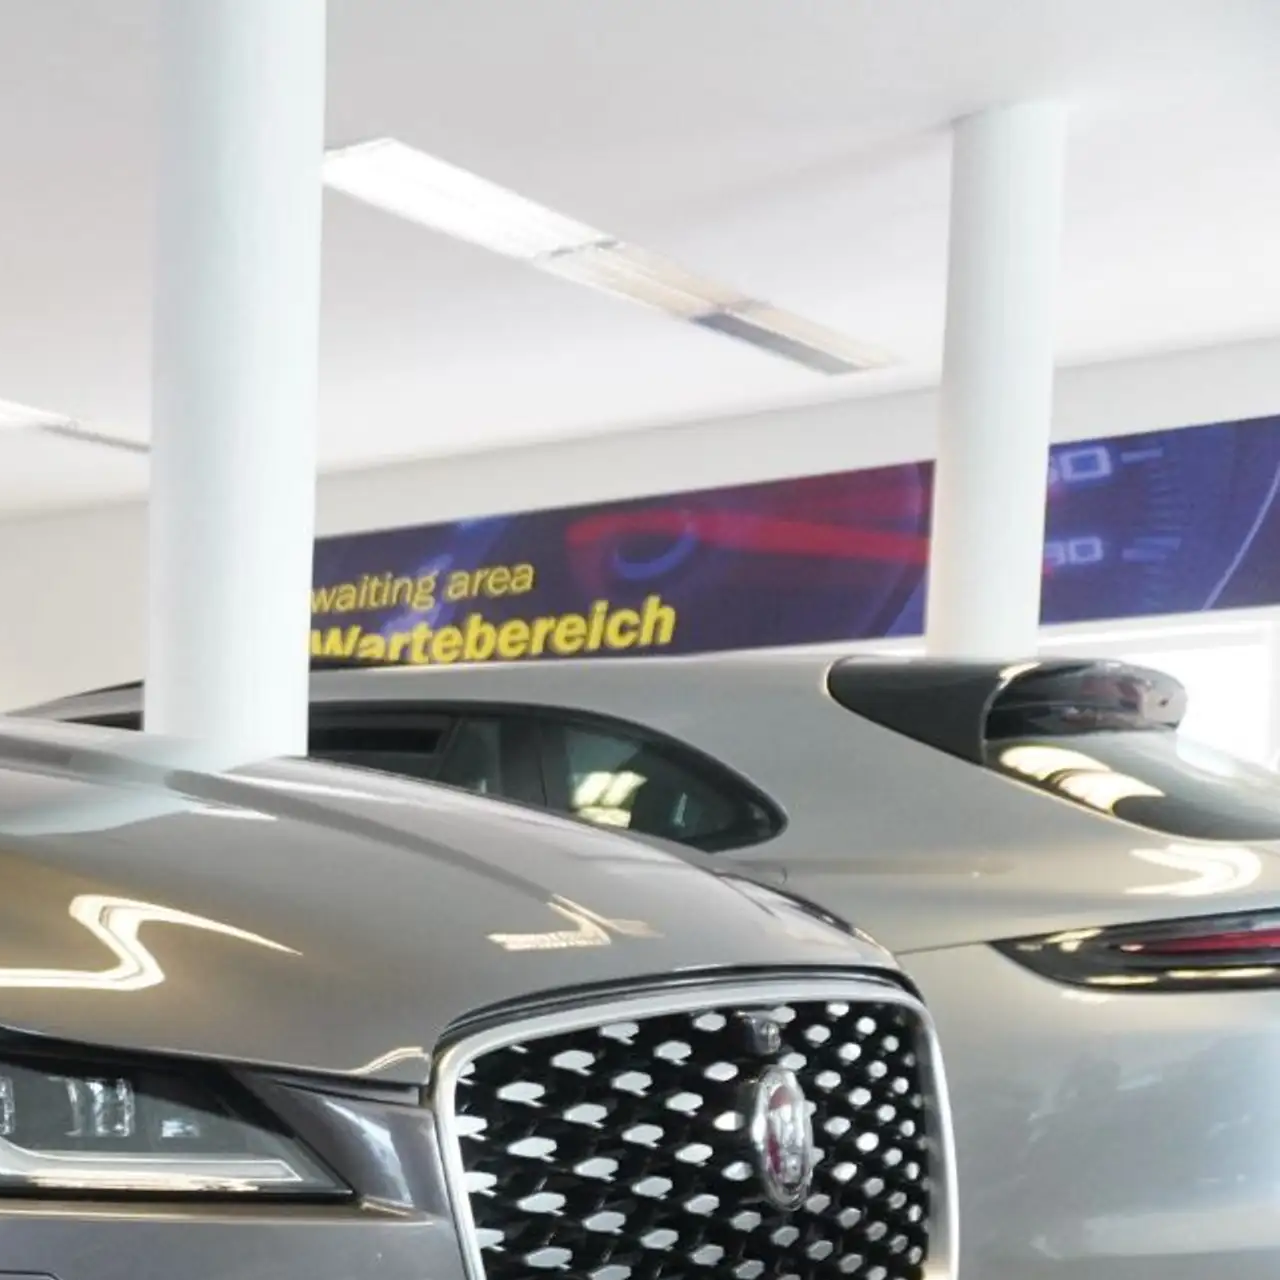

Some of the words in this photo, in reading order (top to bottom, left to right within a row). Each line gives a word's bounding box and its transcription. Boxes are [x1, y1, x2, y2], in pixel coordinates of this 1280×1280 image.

[310, 570, 438, 611] waiting
[447, 563, 534, 599] area
[310, 594, 676, 663] Wartebereich
